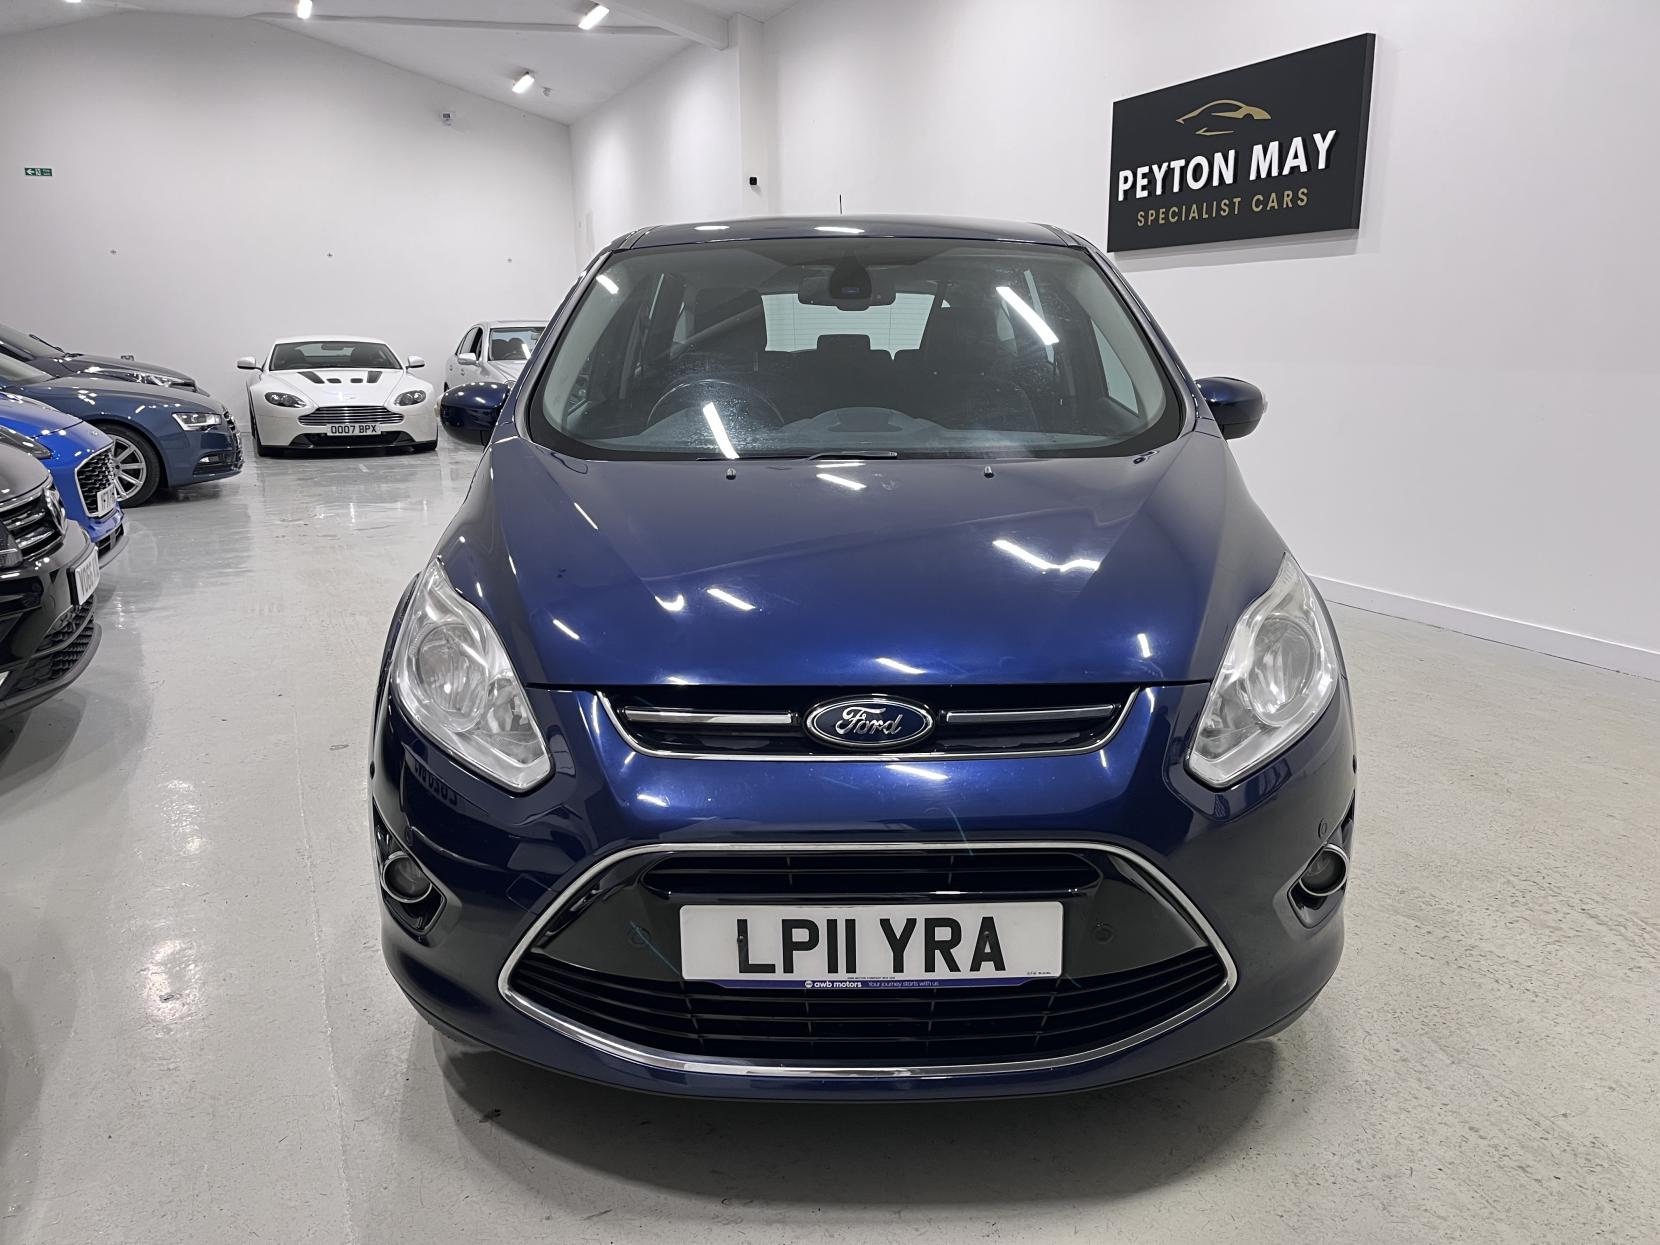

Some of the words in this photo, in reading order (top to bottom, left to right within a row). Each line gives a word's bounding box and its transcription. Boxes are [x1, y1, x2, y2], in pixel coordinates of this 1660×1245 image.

[1117, 149, 1236, 202] PEYTON
[1249, 129, 1337, 181] MAY
[1137, 197, 1241, 227] SPECIALIST
[1251, 187, 1309, 213] CARS
[358, 424, 377, 433] BPX
[835, 706, 904, 735] Ford
[736, 918, 857, 974] LP11
[879, 916, 1006, 974] YRA
